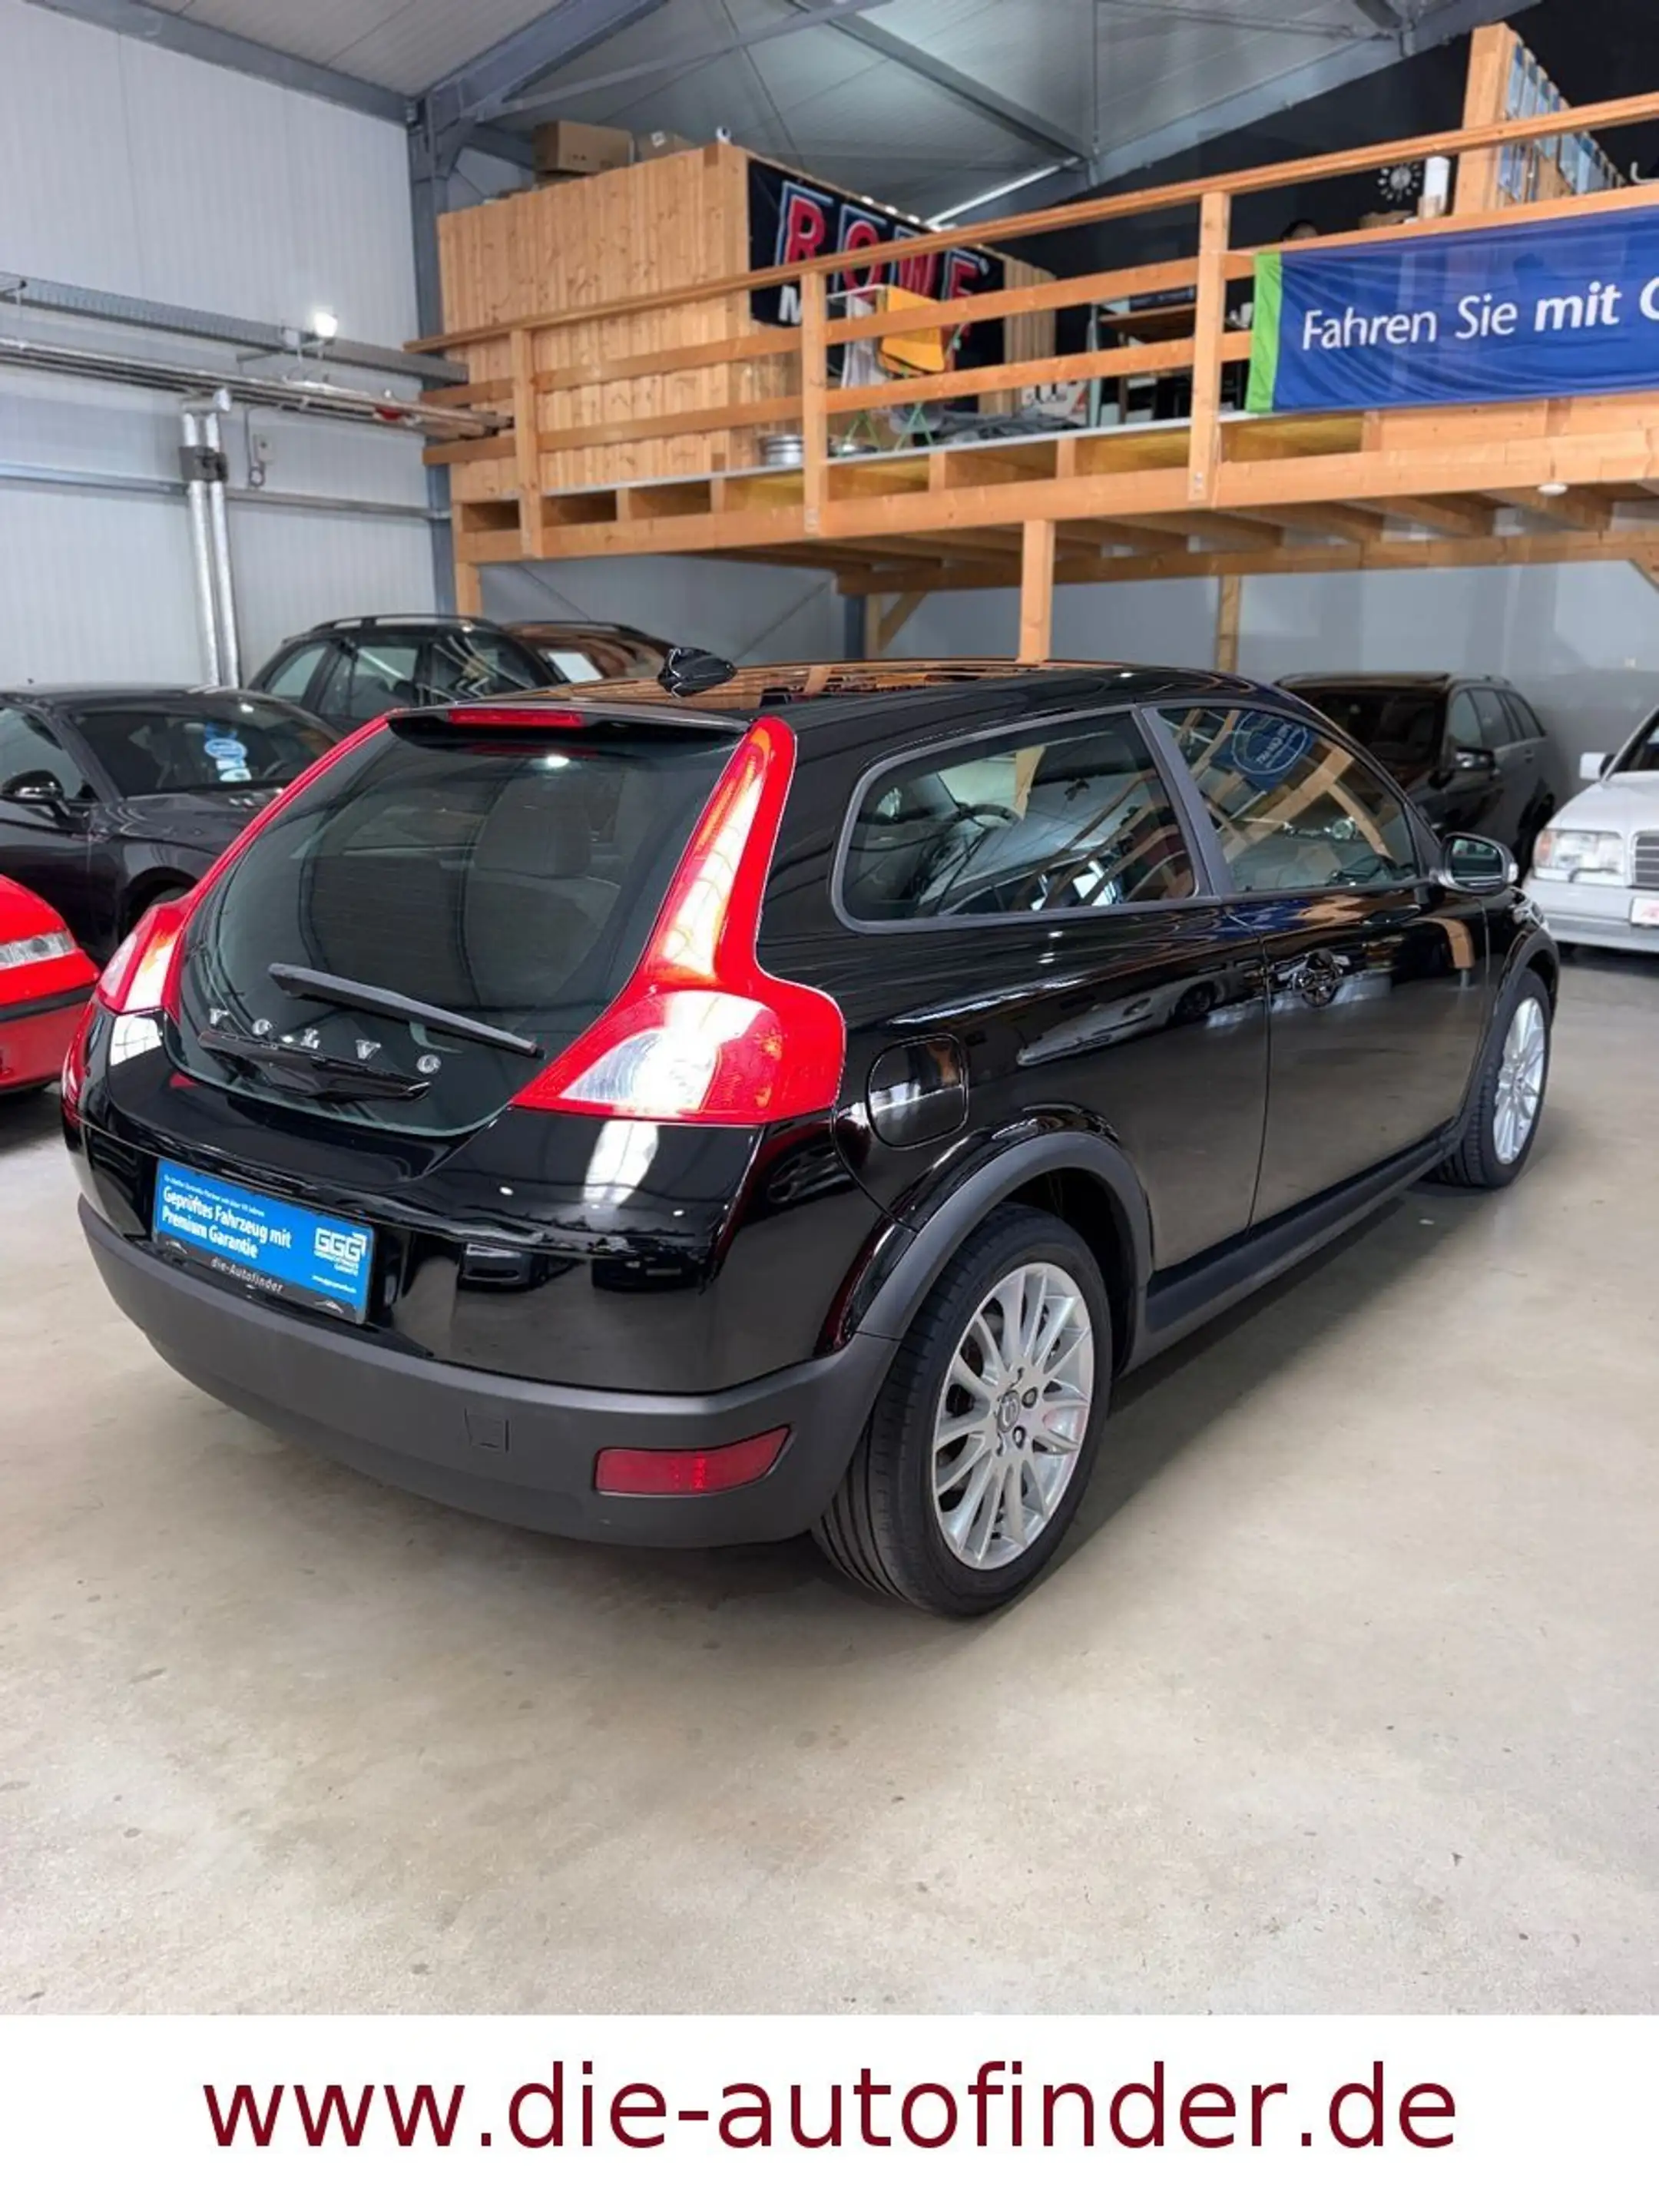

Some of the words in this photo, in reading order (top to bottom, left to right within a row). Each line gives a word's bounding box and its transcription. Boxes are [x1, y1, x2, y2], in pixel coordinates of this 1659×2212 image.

[1302, 307, 1436, 349] Fahren
[1455, 293, 1518, 339] Sie
[1535, 281, 1622, 331] mit
[209, 1007, 442, 1074] VOLVO
[161, 1204, 208, 1240] Premium
[208, 1224, 259, 1259] Garantie
[163, 1185, 214, 1220] Geprüftes
[214, 1204, 269, 1244] Fahrzeug
[270, 1228, 292, 1249] mit
[315, 1227, 363, 1263] GGG
